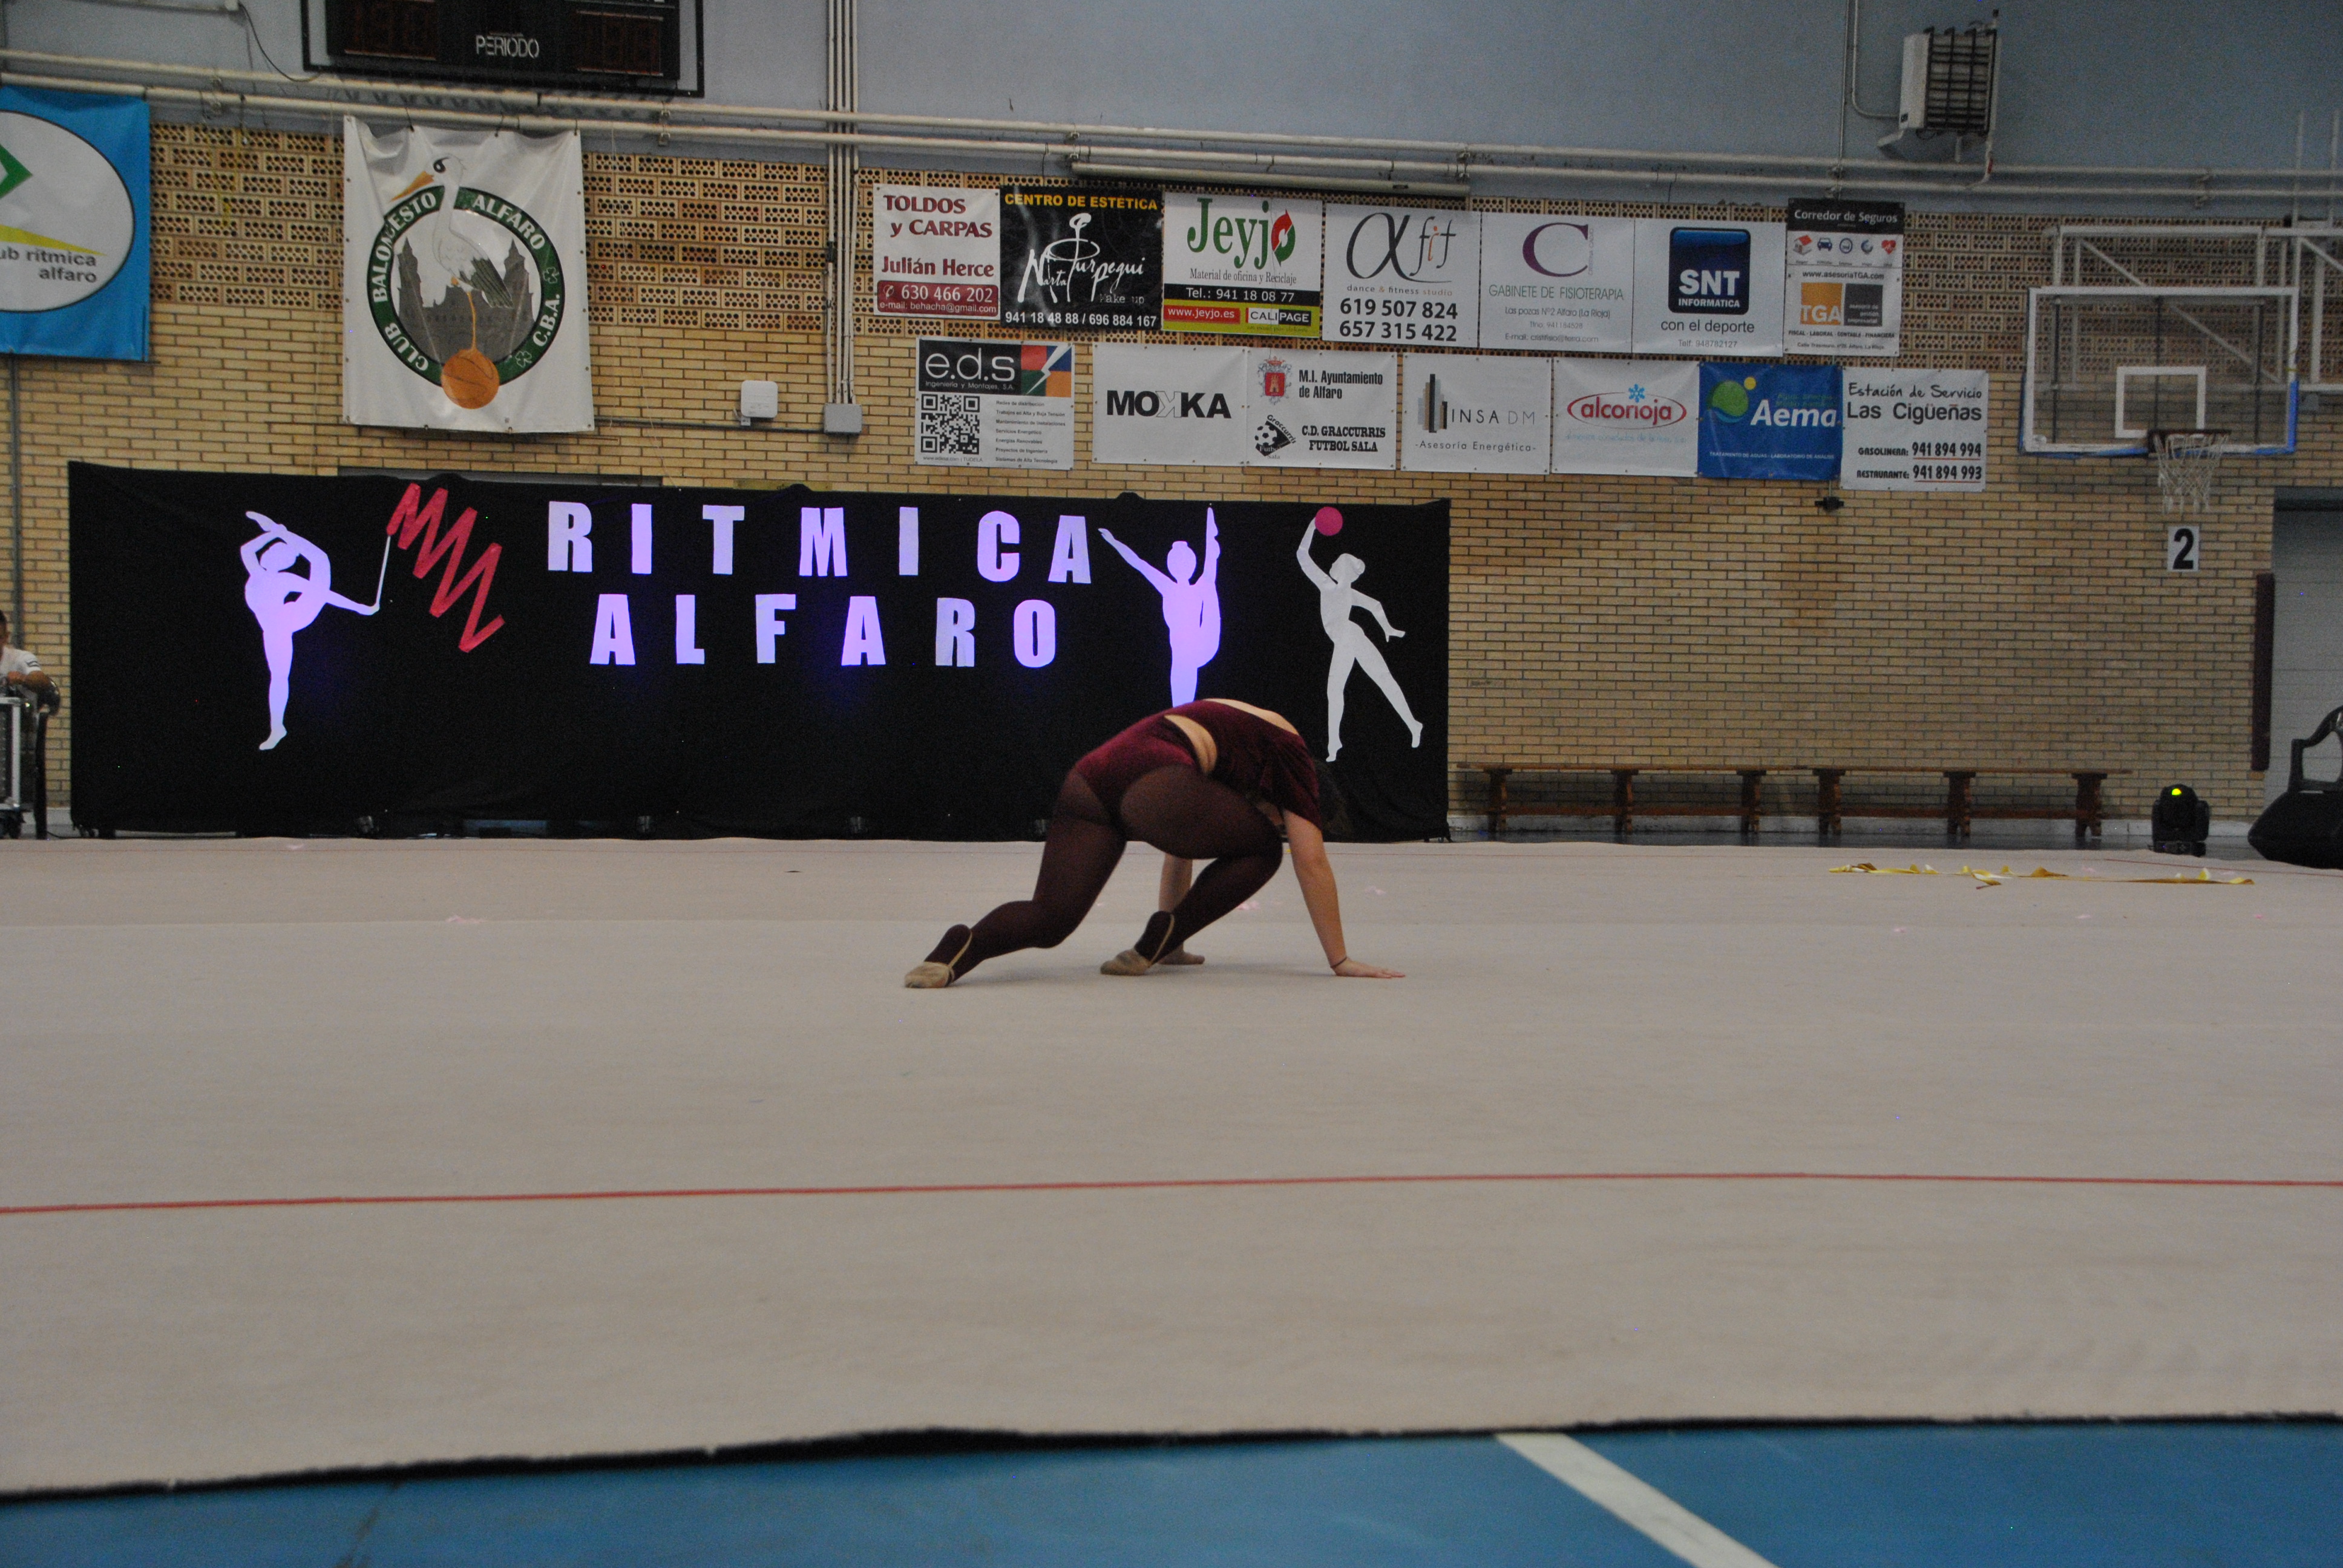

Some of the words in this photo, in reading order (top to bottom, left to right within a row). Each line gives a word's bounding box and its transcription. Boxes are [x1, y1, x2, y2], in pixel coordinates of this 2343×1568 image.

[476, 35, 540, 59] PERIODO
[883, 195, 966, 214] TOLDOS
[1004, 194, 1063, 206] CENTRO
[1067, 195, 1086, 207] DE
[1090, 195, 1158, 210] ESTÉTICA
[1794, 209, 1842, 221] Corredor
[1844, 211, 1855, 221] de
[1858, 212, 1898, 225] Seguros
[890, 222, 903, 237] y
[909, 220, 992, 238] CARPAS
[27, 248, 97, 267] ritmica
[39, 267, 97, 283] alfaro
[882, 256, 936, 275] Julián
[943, 258, 994, 277] Herce
[385, 322, 428, 371] CLUB
[472, 194, 545, 249] ALFARO
[532, 294, 560, 347] C.B.A.
[1190, 268, 1221, 280] Material
[1224, 270, 1231, 280] de
[1233, 270, 1257, 283] oficina
[1259, 274, 1263, 284] y
[1265, 272, 1297, 286] Reciclaje
[1679, 269, 1740, 296] SNT
[902, 284, 929, 299] 630
[934, 287, 961, 301] 466
[966, 288, 993, 302] 202
[1186, 287, 1210, 298] Tel.:
[1216, 289, 1237, 300] 941
[1244, 290, 1257, 301] 18
[1261, 291, 1276, 302] 08
[1280, 292, 1295, 302] 77
[1347, 284, 1375, 293] dance
[1389, 286, 1419, 295] fitness
[1489, 284, 1537, 298] GABINETE
[1541, 286, 1555, 298] DE
[1559, 287, 1624, 300] FISIOTERAPIA
[910, 302, 997, 313] behacha@gmail.com
[1340, 298, 1376, 316] 619
[1381, 300, 1417, 318] 507
[1422, 302, 1458, 320] 824
[1678, 298, 1740, 308] INFORMATICA
[1005, 312, 1026, 324] 941
[1031, 312, 1044, 324] 18
[1047, 313, 1062, 324] 48
[1065, 313, 1079, 324] 88
[1089, 314, 1109, 325] 696
[1113, 315, 1133, 327] 884
[1137, 315, 1157, 327] 167
[1168, 307, 1235, 319] www.jeyjo.es
[1557, 309, 1576, 317] Alfaro
[1591, 310, 1610, 319] Rioja)
[1801, 305, 1842, 323] TGA
[1340, 320, 1375, 338] 657
[1381, 322, 1416, 340] 315
[1421, 324, 1457, 342] 422
[1660, 321, 1685, 332] con
[1689, 319, 1700, 331] el
[1705, 319, 1755, 335] deporte
[925, 347, 1015, 382] e.d.s
[1299, 369, 1318, 383] M.I.
[1321, 370, 1383, 385] Ayuntamiento
[1299, 385, 1310, 398] de
[1313, 385, 1343, 399] Alfaro
[1849, 382, 1902, 397] Estación
[1909, 385, 1925, 397] de
[1930, 384, 1982, 399] Servicio
[1452, 408, 1499, 424] INSA
[1508, 411, 1535, 425] DM
[1581, 396, 1672, 426] alcorioja
[1750, 399, 1837, 427] Aema
[1847, 402, 1881, 419] Las
[1893, 402, 1982, 425] Cigüeñas
[1302, 425, 1319, 436] C.D.
[1321, 426, 1386, 438] GRACCURRIS
[1309, 440, 1349, 452] FUTBOL
[1351, 441, 1378, 452] SALA
[1858, 448, 1909, 457] GASOLINERA:
[1912, 442, 1932, 456] 941
[1935, 442, 1956, 457] 894
[1959, 443, 1982, 457] 994
[1856, 470, 1910, 479] RESTAURANTE:
[1912, 465, 1932, 479] 941
[1936, 465, 1957, 480] 894
[1961, 466, 1982, 480] 993
[2173, 528, 2195, 570] 2
[589, 593, 1057, 668] ALFARO
